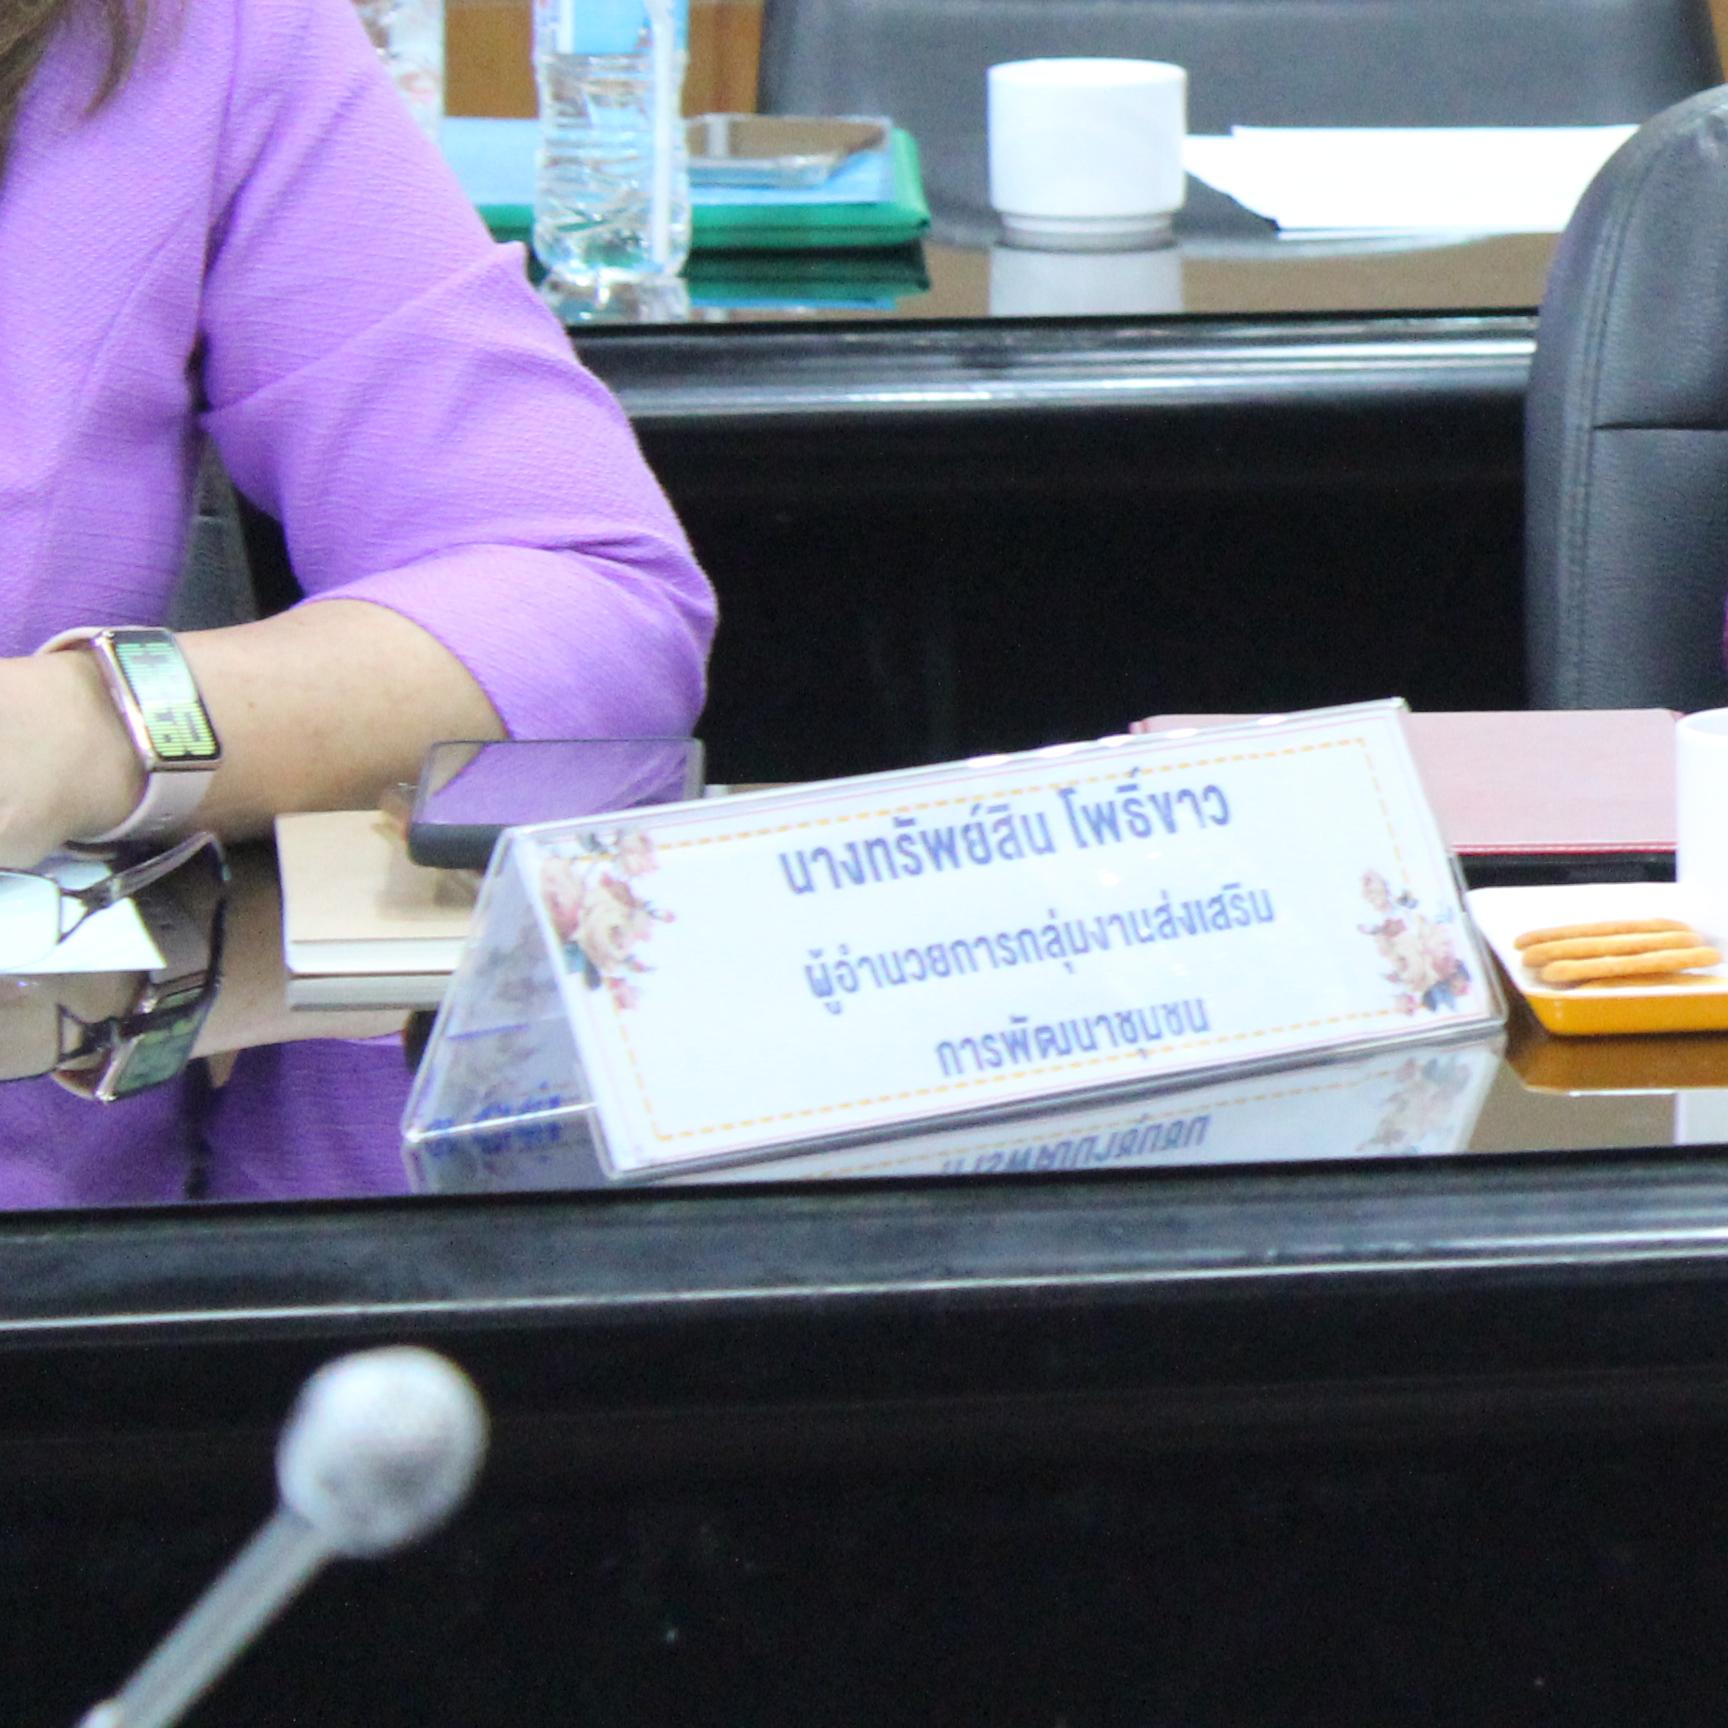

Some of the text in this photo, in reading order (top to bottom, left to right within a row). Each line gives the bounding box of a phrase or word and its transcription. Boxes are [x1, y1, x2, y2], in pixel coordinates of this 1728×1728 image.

[778, 766, 1231, 895] นางทรัพย์สิน โพธิ์ขาว
[804, 881, 1277, 1015] ผู้อำนวยการกลุ่มงานส่งเสริม
[935, 997, 1212, 1077] การพัฒนาชุมชน
